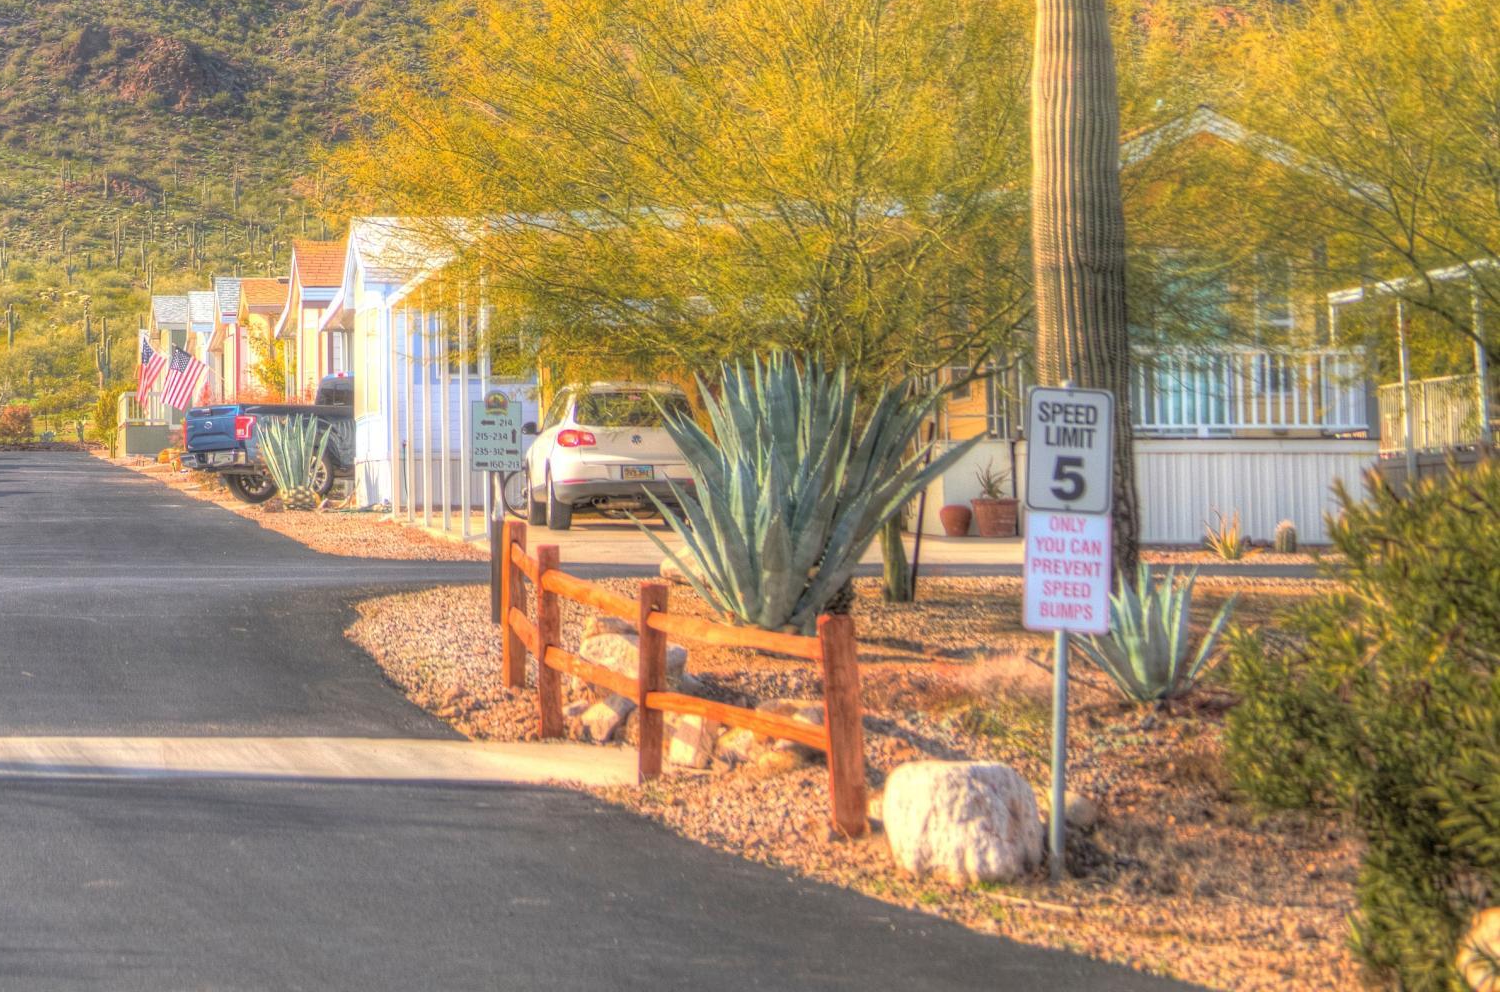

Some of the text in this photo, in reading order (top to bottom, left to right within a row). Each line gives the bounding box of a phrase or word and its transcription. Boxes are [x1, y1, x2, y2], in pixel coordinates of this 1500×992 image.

[1037, 401, 1098, 425] SPEED
[475, 432, 508, 441] 215-234
[1044, 425, 1097, 449] LIMIT
[474, 448, 505, 456] 235-312
[1050, 455, 1086, 501] 5
[1049, 515, 1087, 535] ONLY
[1034, 536, 1102, 556] YOU CAN
[1031, 559, 1103, 578] PREVENT
[1042, 580, 1091, 598] SPEED
[1039, 601, 1093, 621] BUMPS
